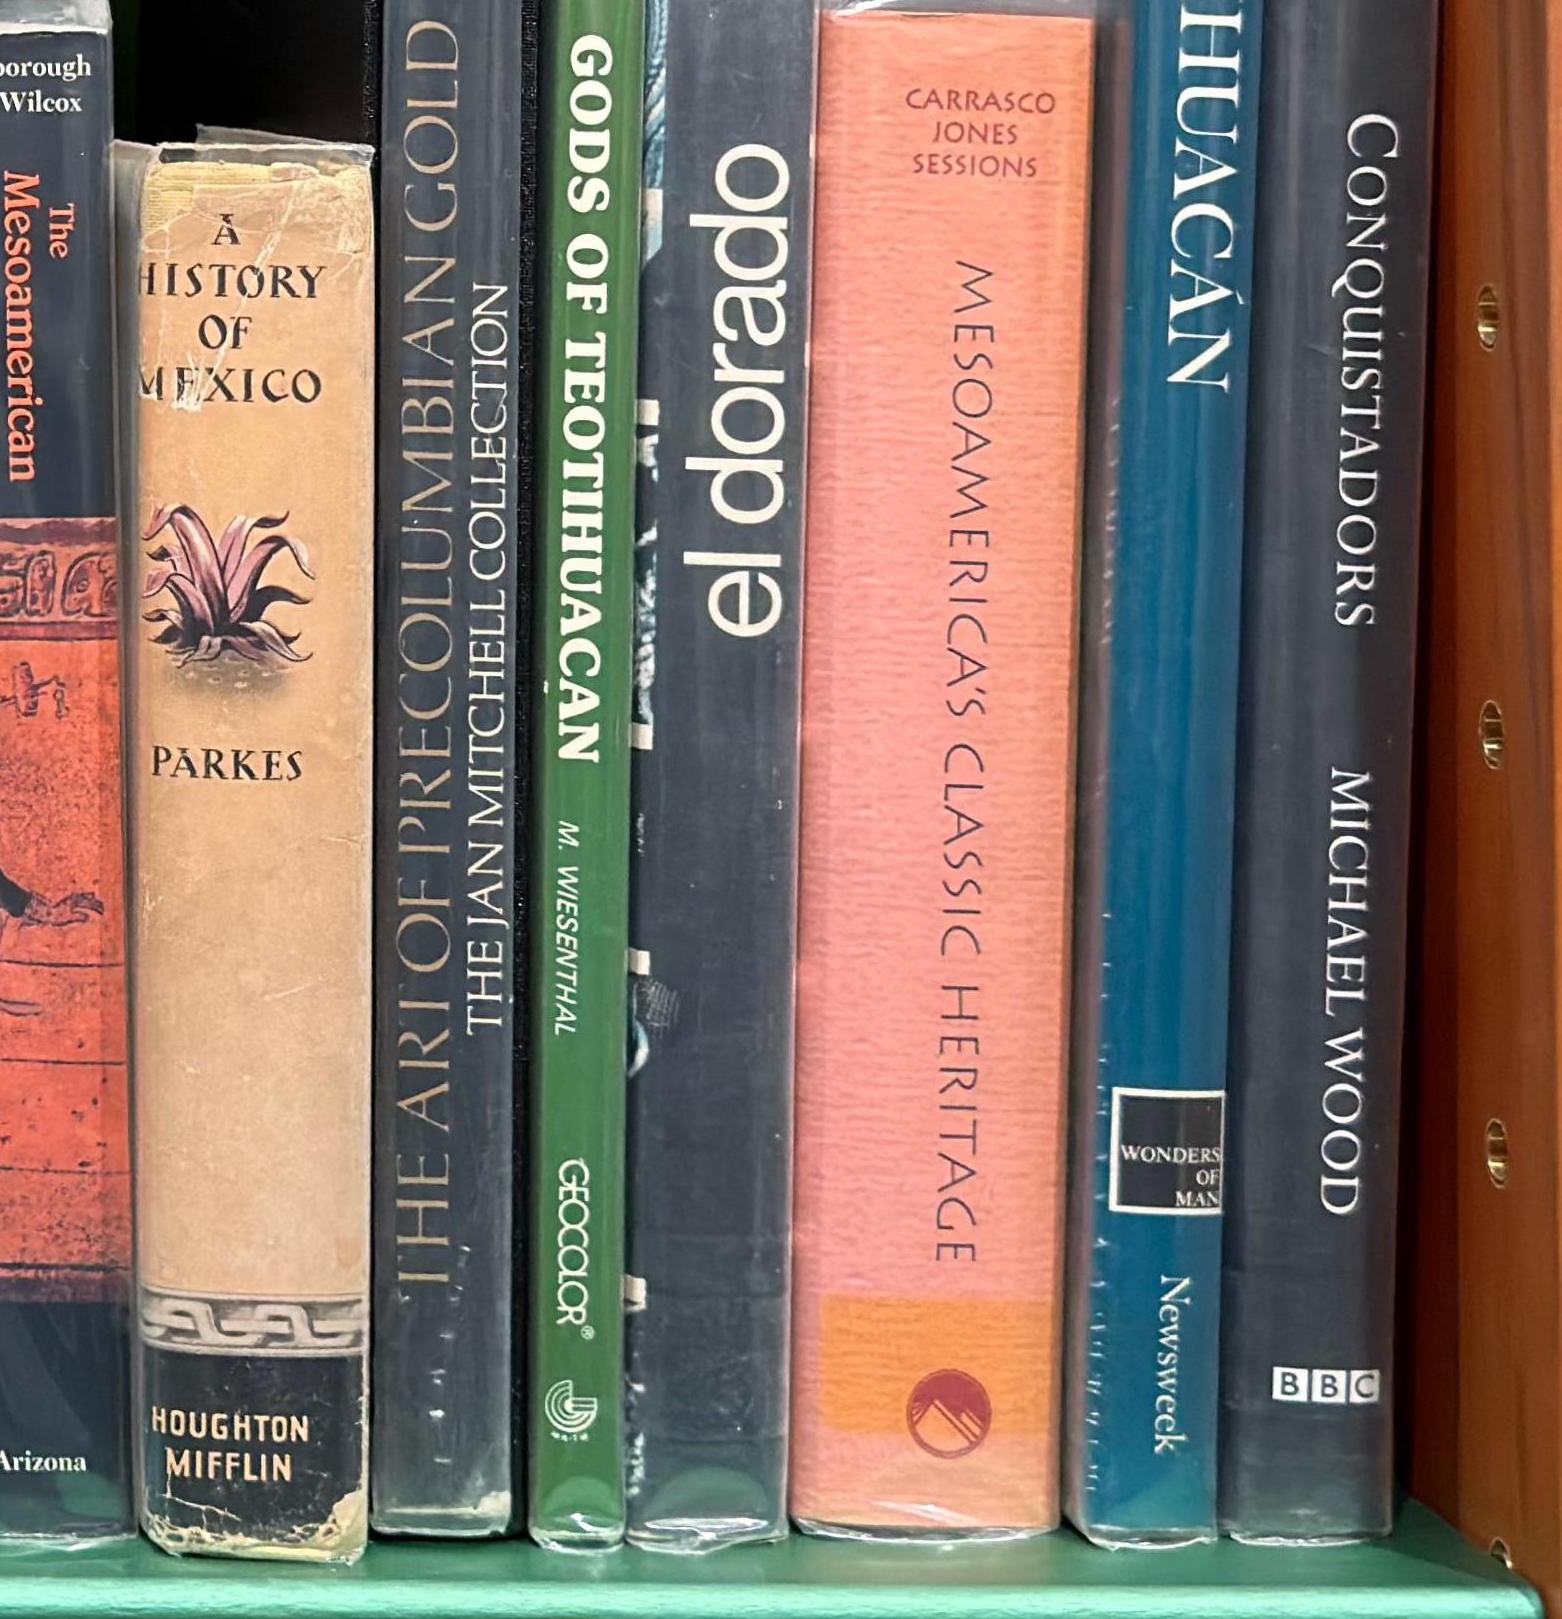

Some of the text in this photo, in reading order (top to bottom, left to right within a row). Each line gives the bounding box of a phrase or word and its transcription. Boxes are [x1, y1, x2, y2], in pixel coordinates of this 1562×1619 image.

[0, 90, 83, 113] Wilcox
[905, 87, 1056, 114] CARRASCO
[932, 122, 1017, 144] JONES
[913, 155, 1037, 177] SESSIONS
[48, 203, 76, 259] The
[3, 170, 44, 481] Mesoamerican
[1331, 113, 1402, 628] CONQUISTADORS
[558, 34, 613, 764] GODS OF TEOTIHUACAN
[683, 143, 790, 638] el dorado
[396, 20, 459, 1283] THE ART OF PRECOLUMBIAN GOLD
[151, 745, 303, 781] PARKES
[935, 260, 995, 1261] MESOAMERICA'S CLASSIC HERITAGE
[555, 820, 580, 1036] M. WIESENTHAL
[1320, 766, 1371, 1216] MICHAEL WOOD
[1121, 1144, 1222, 1165] WONDERS
[1196, 1169, 1220, 1185] OF
[1174, 1190, 1220, 1209] MAN
[1153, 1275, 1192, 1454] Newsweek
[1279, 1371, 1376, 1399] BBC
[152, 1406, 309, 1443] HOUGHTON
[165, 1447, 293, 1482] MIFFLIN
